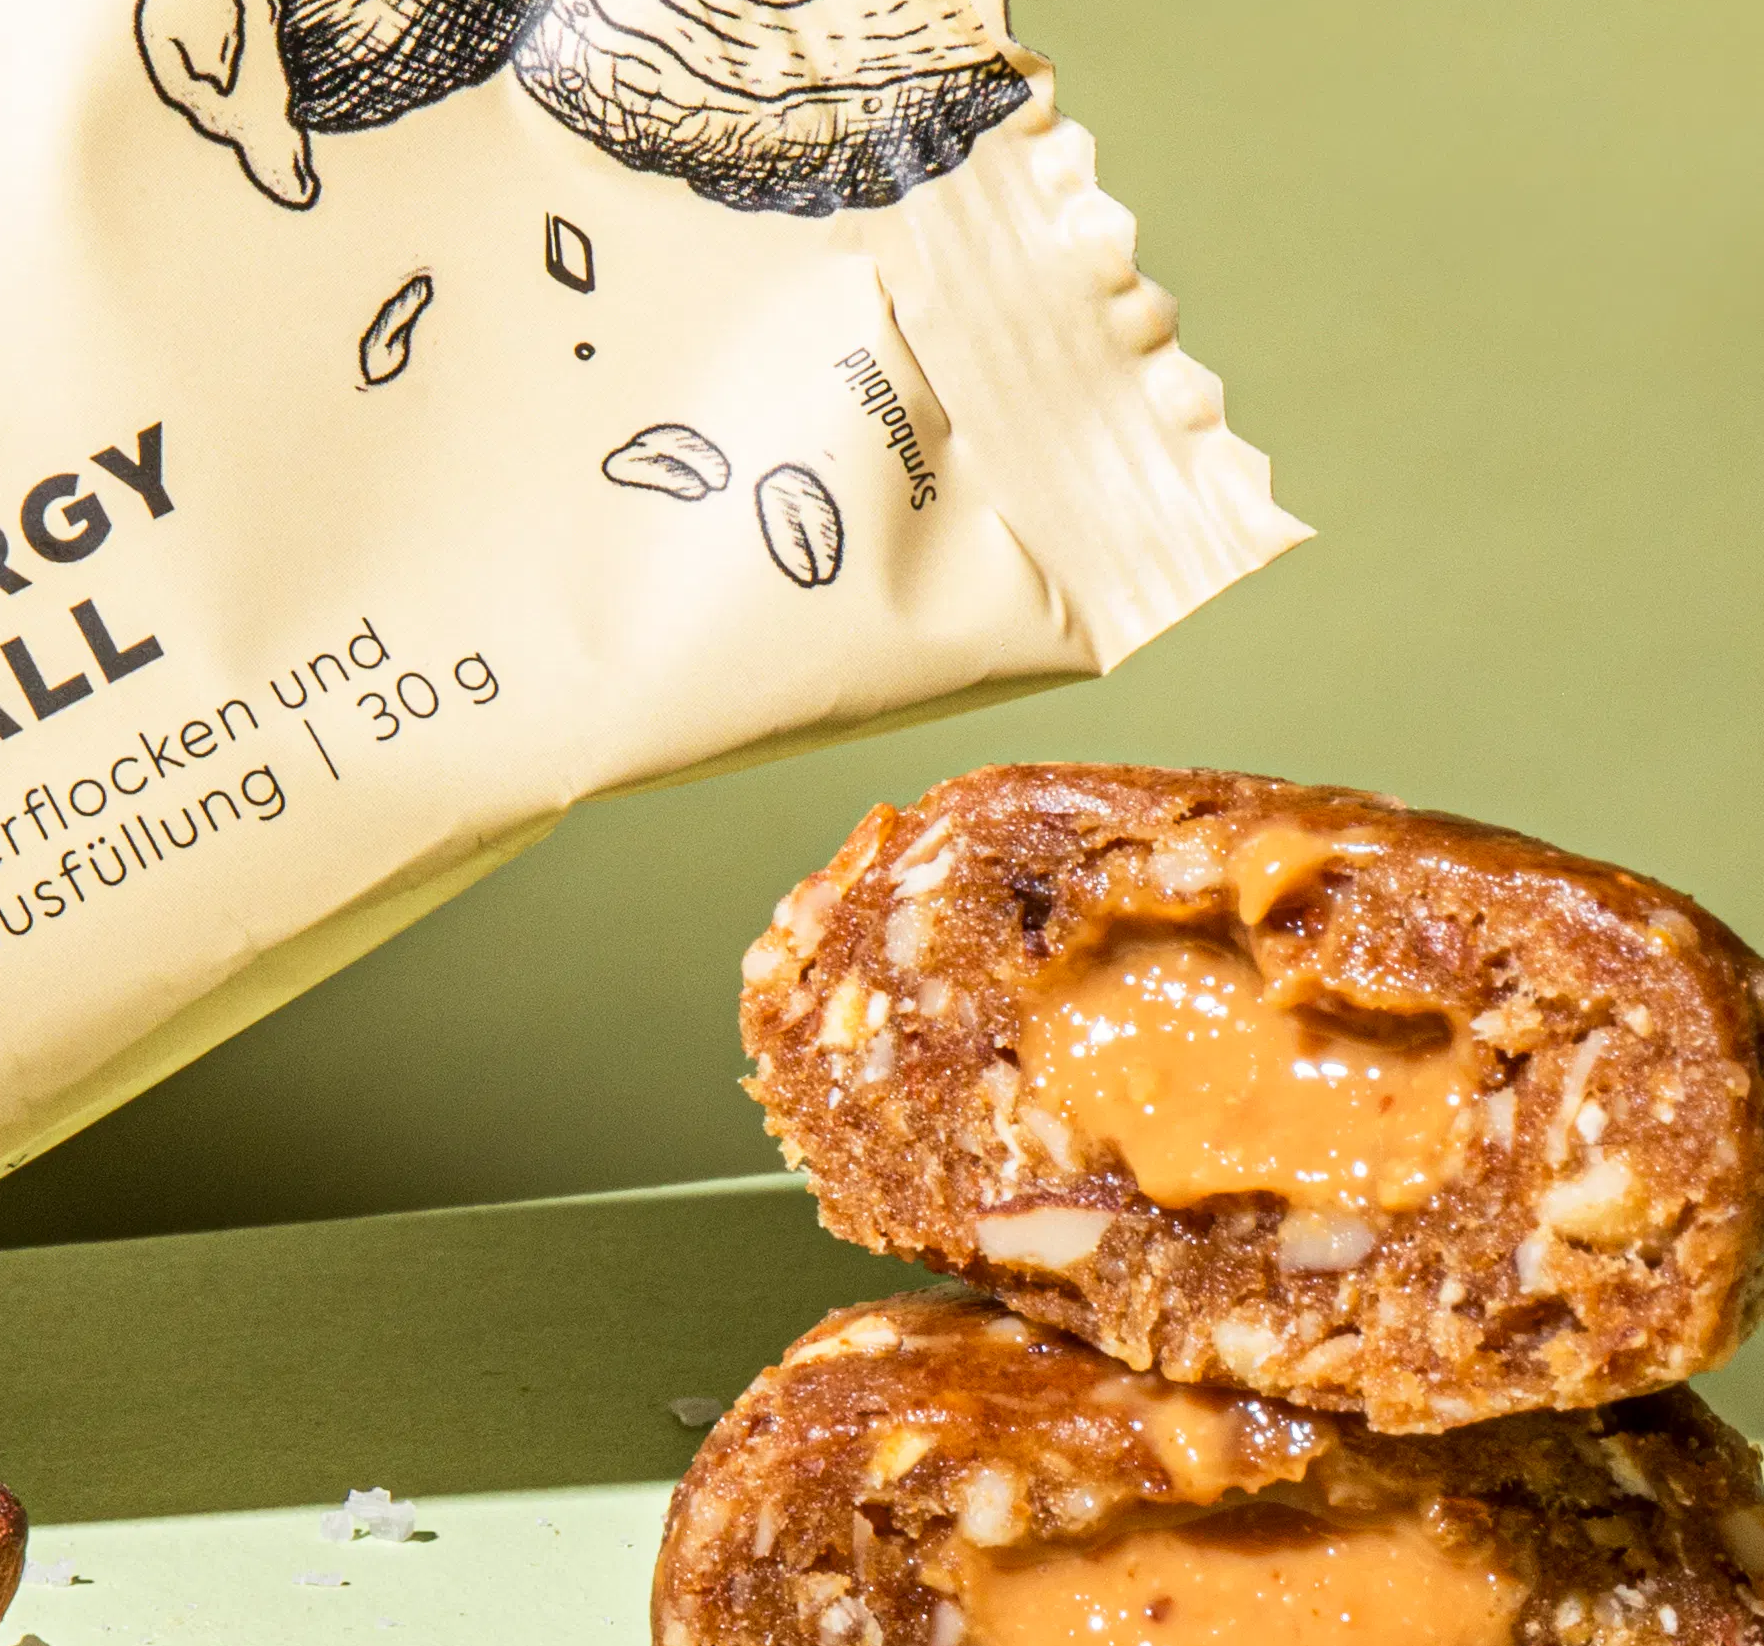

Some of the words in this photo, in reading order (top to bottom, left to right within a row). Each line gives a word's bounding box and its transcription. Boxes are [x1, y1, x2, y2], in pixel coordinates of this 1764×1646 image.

[835, 348, 936, 511] Symbolbild
[270, 617, 390, 709] und
[373, 673, 439, 741] 30
[455, 653, 499, 704] g
